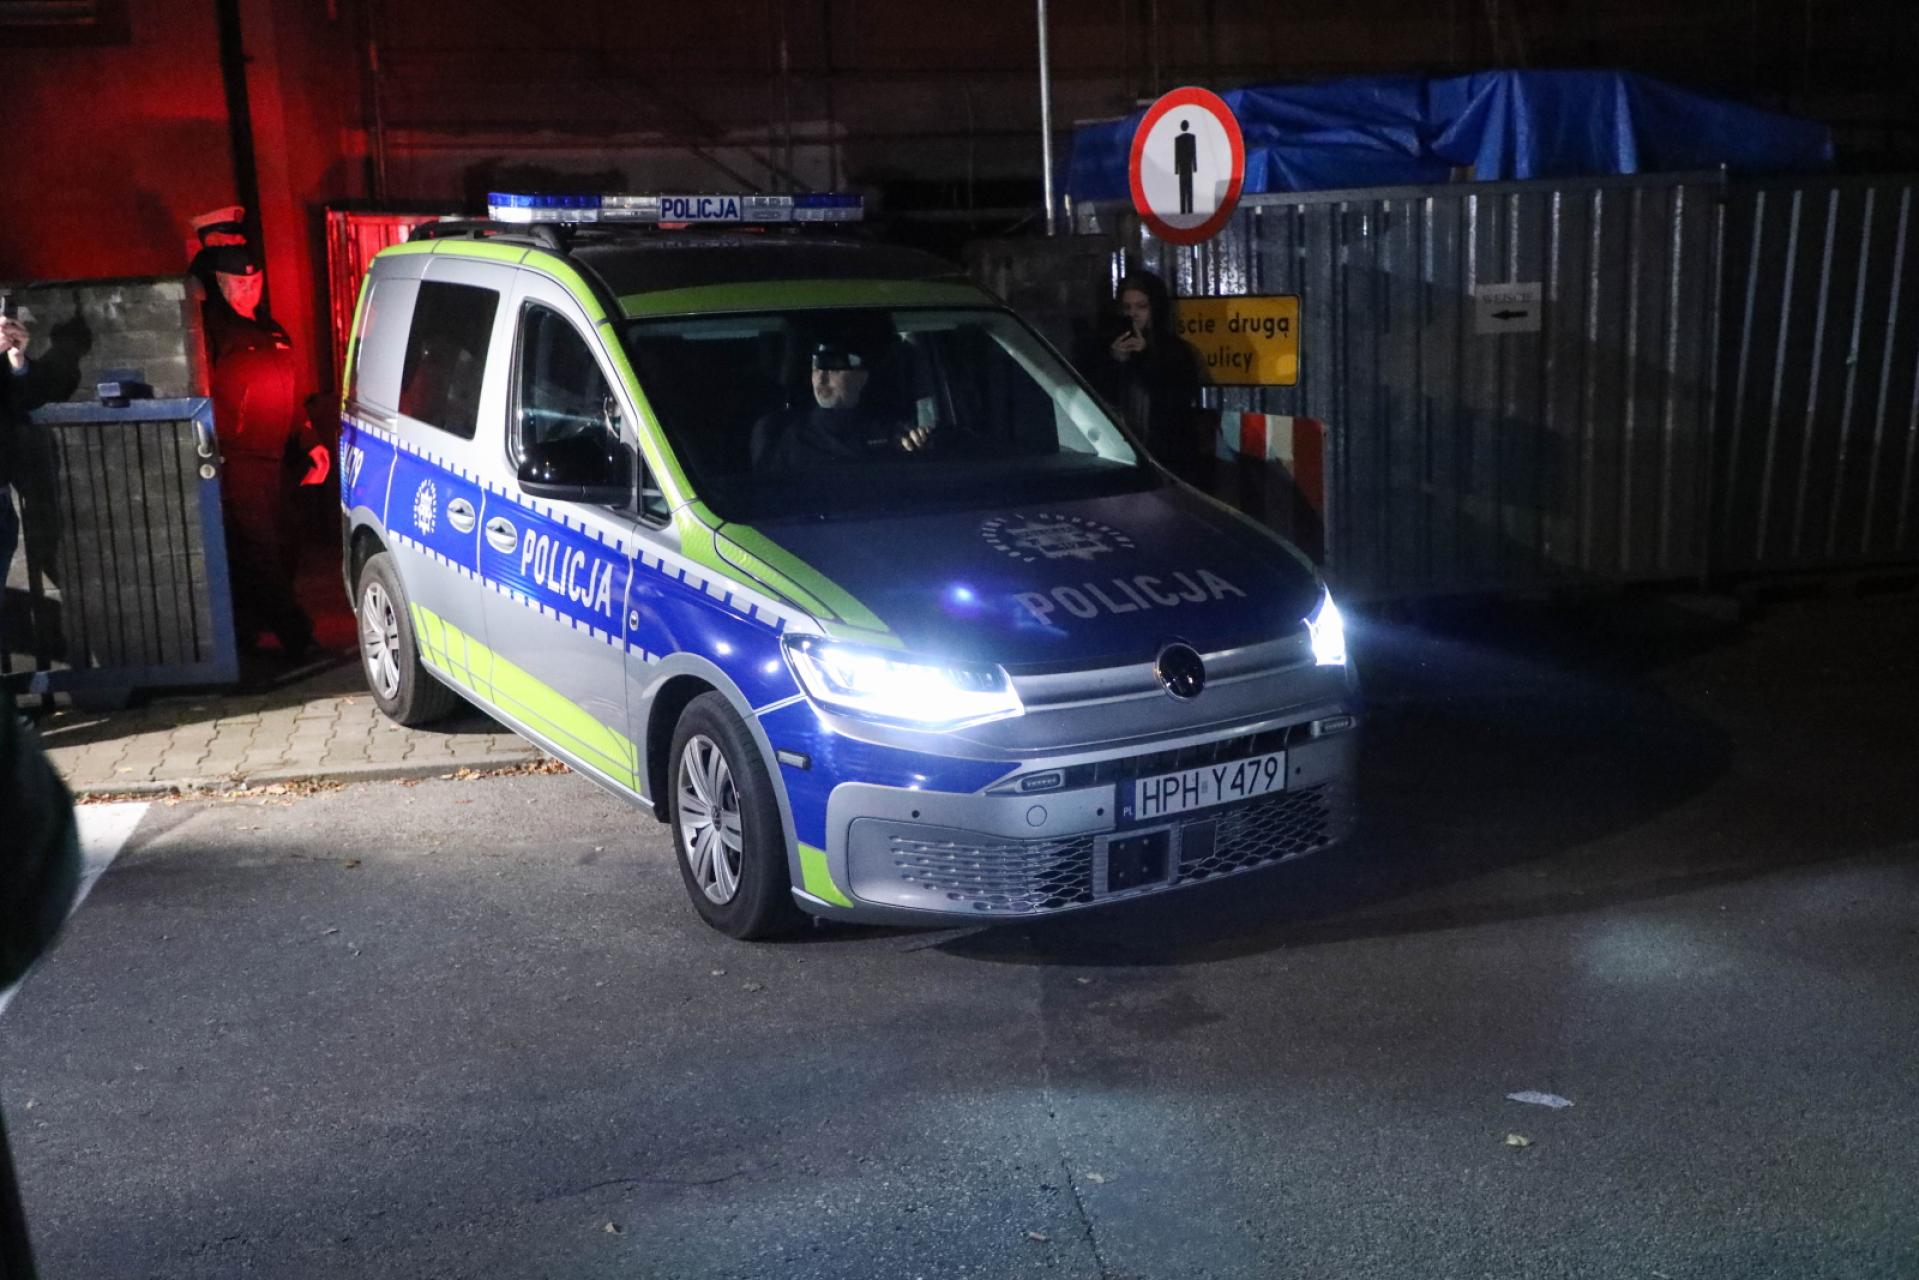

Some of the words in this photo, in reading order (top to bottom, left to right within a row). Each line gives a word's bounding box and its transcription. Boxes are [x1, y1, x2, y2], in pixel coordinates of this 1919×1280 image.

[661, 198, 738, 218] POLICJA
[1228, 312, 1290, 339] drugą
[1207, 345, 1254, 374] ulicy
[521, 528, 614, 617] POLICJA
[1013, 569, 1248, 626] POLICJA
[1142, 771, 1199, 817] HPH
[1212, 756, 1278, 801] Y479
[1123, 806, 1134, 817] PL
